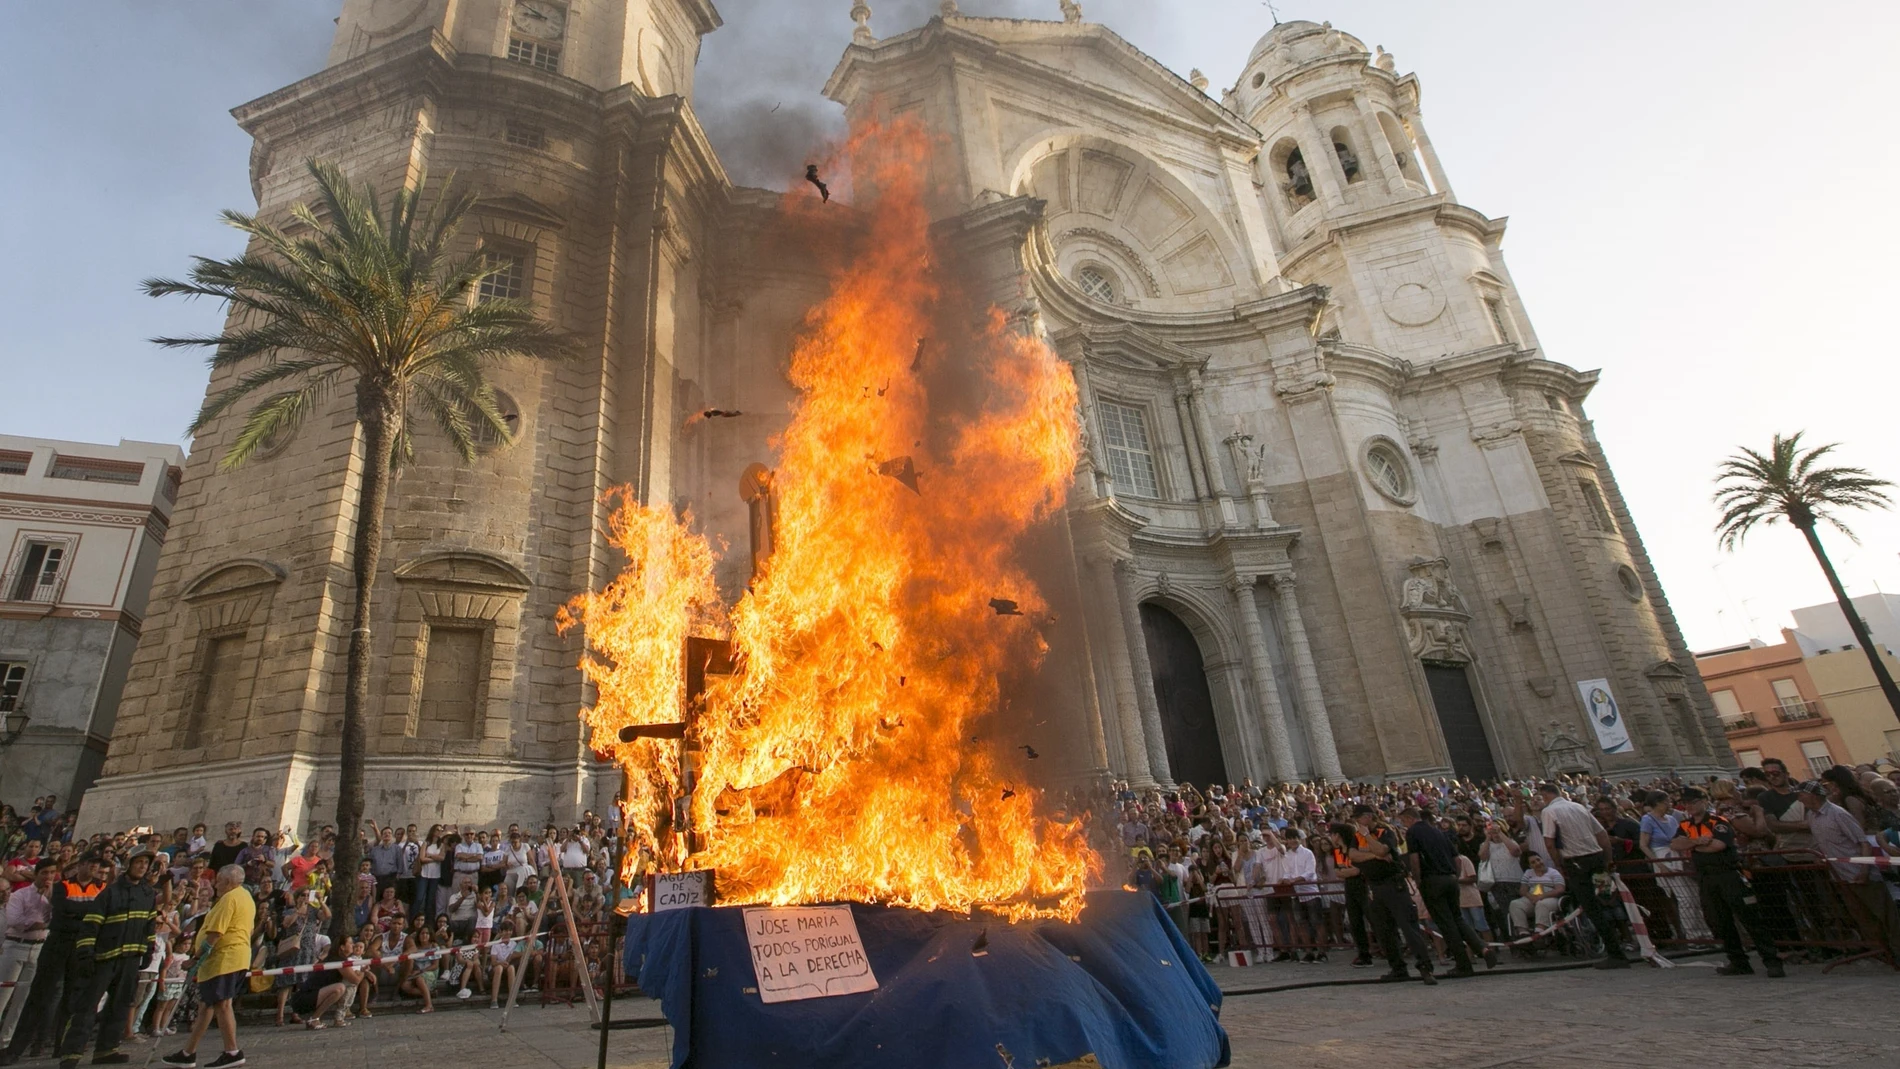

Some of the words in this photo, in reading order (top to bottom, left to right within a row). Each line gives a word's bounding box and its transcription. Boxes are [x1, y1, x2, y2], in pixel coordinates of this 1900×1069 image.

[659, 872, 703, 884] AGUAS
[672, 882, 684, 891] DE
[660, 888, 700, 905] CADIZ
[757, 915, 790, 936] JOSE
[797, 911, 839, 931] MARIA
[753, 940, 801, 962] TODOS
[804, 933, 857, 953] PORIGUAL
[763, 966, 773, 982] A
[779, 962, 799, 977] LA
[806, 949, 864, 973] DERECHA
